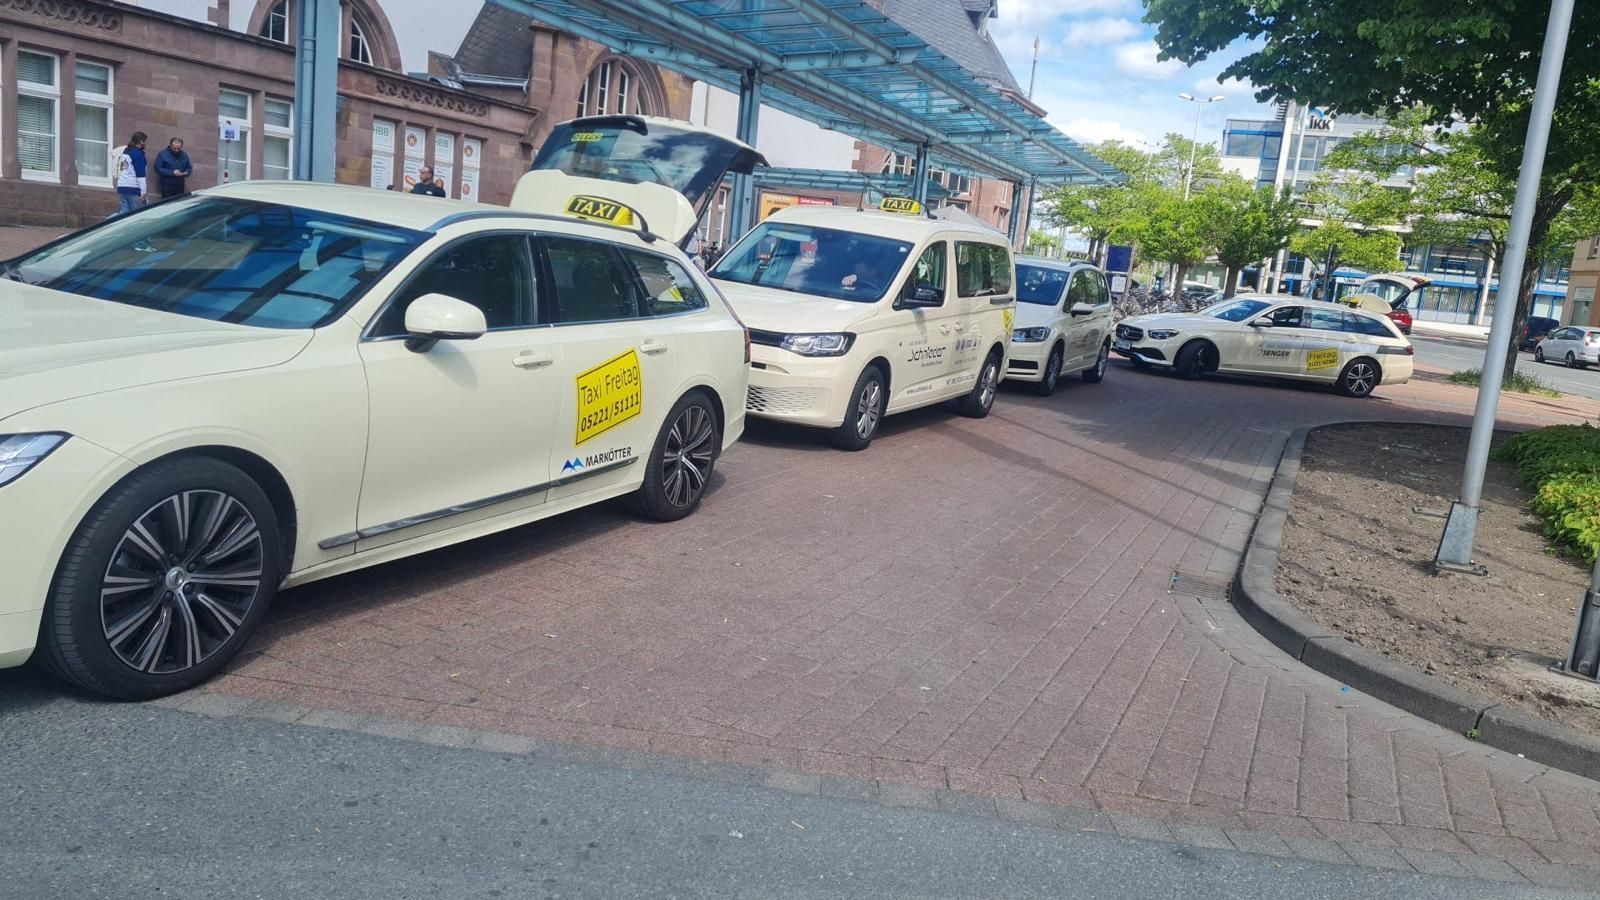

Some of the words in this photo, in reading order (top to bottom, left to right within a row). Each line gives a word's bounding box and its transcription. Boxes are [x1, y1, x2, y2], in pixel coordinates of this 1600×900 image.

[574, 199, 615, 218] TAXI
[885, 200, 911, 210] TAXI
[1263, 349, 1290, 357] SENGER
[580, 378, 602, 407] Taxi
[605, 366, 638, 395] Freitag
[581, 391, 640, 432] 05221/51111
[586, 447, 631, 467] MARKÖTTER
